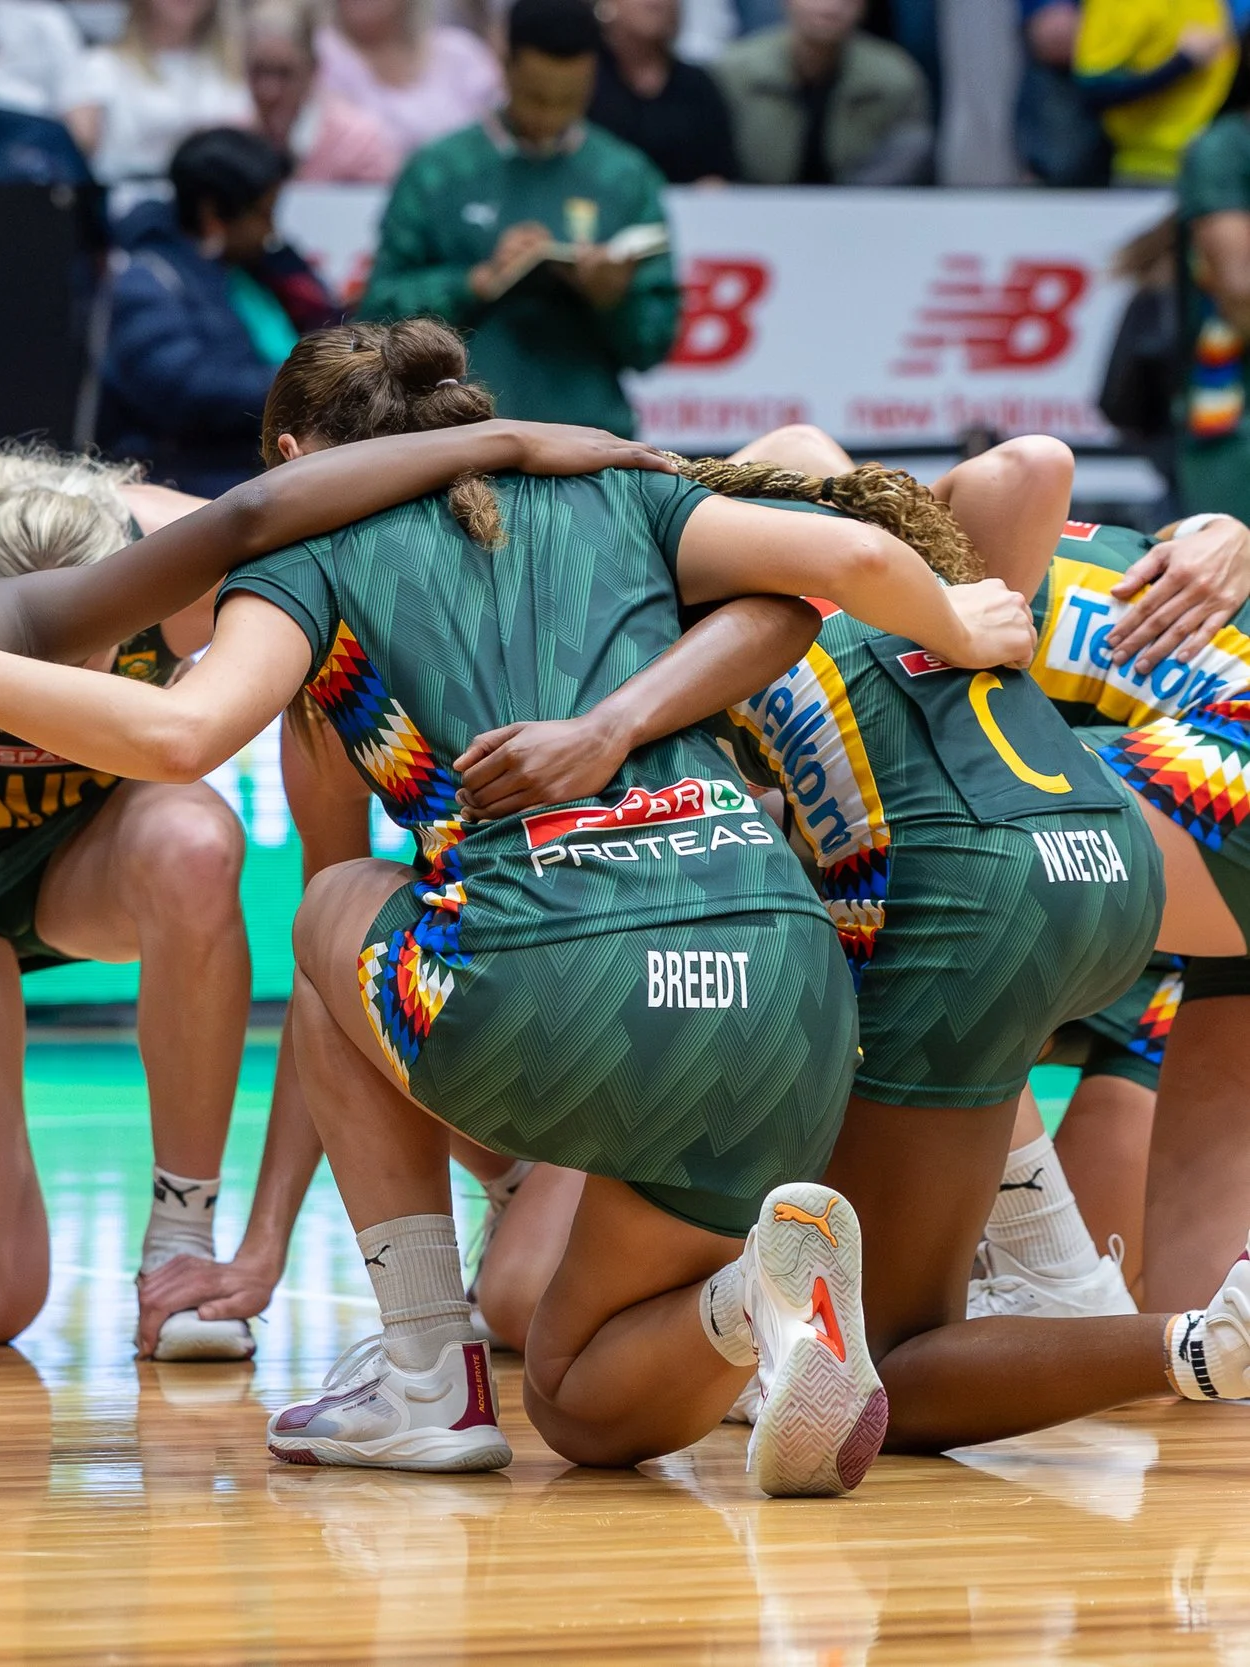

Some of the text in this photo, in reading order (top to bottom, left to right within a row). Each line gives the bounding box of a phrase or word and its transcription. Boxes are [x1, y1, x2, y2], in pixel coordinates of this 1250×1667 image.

[530, 821, 774, 878] PROTEAS
[1032, 829, 1129, 883] NKETSA
[647, 950, 749, 1009] BREEDT
[473, 1354, 485, 1413] ACCELERATE
